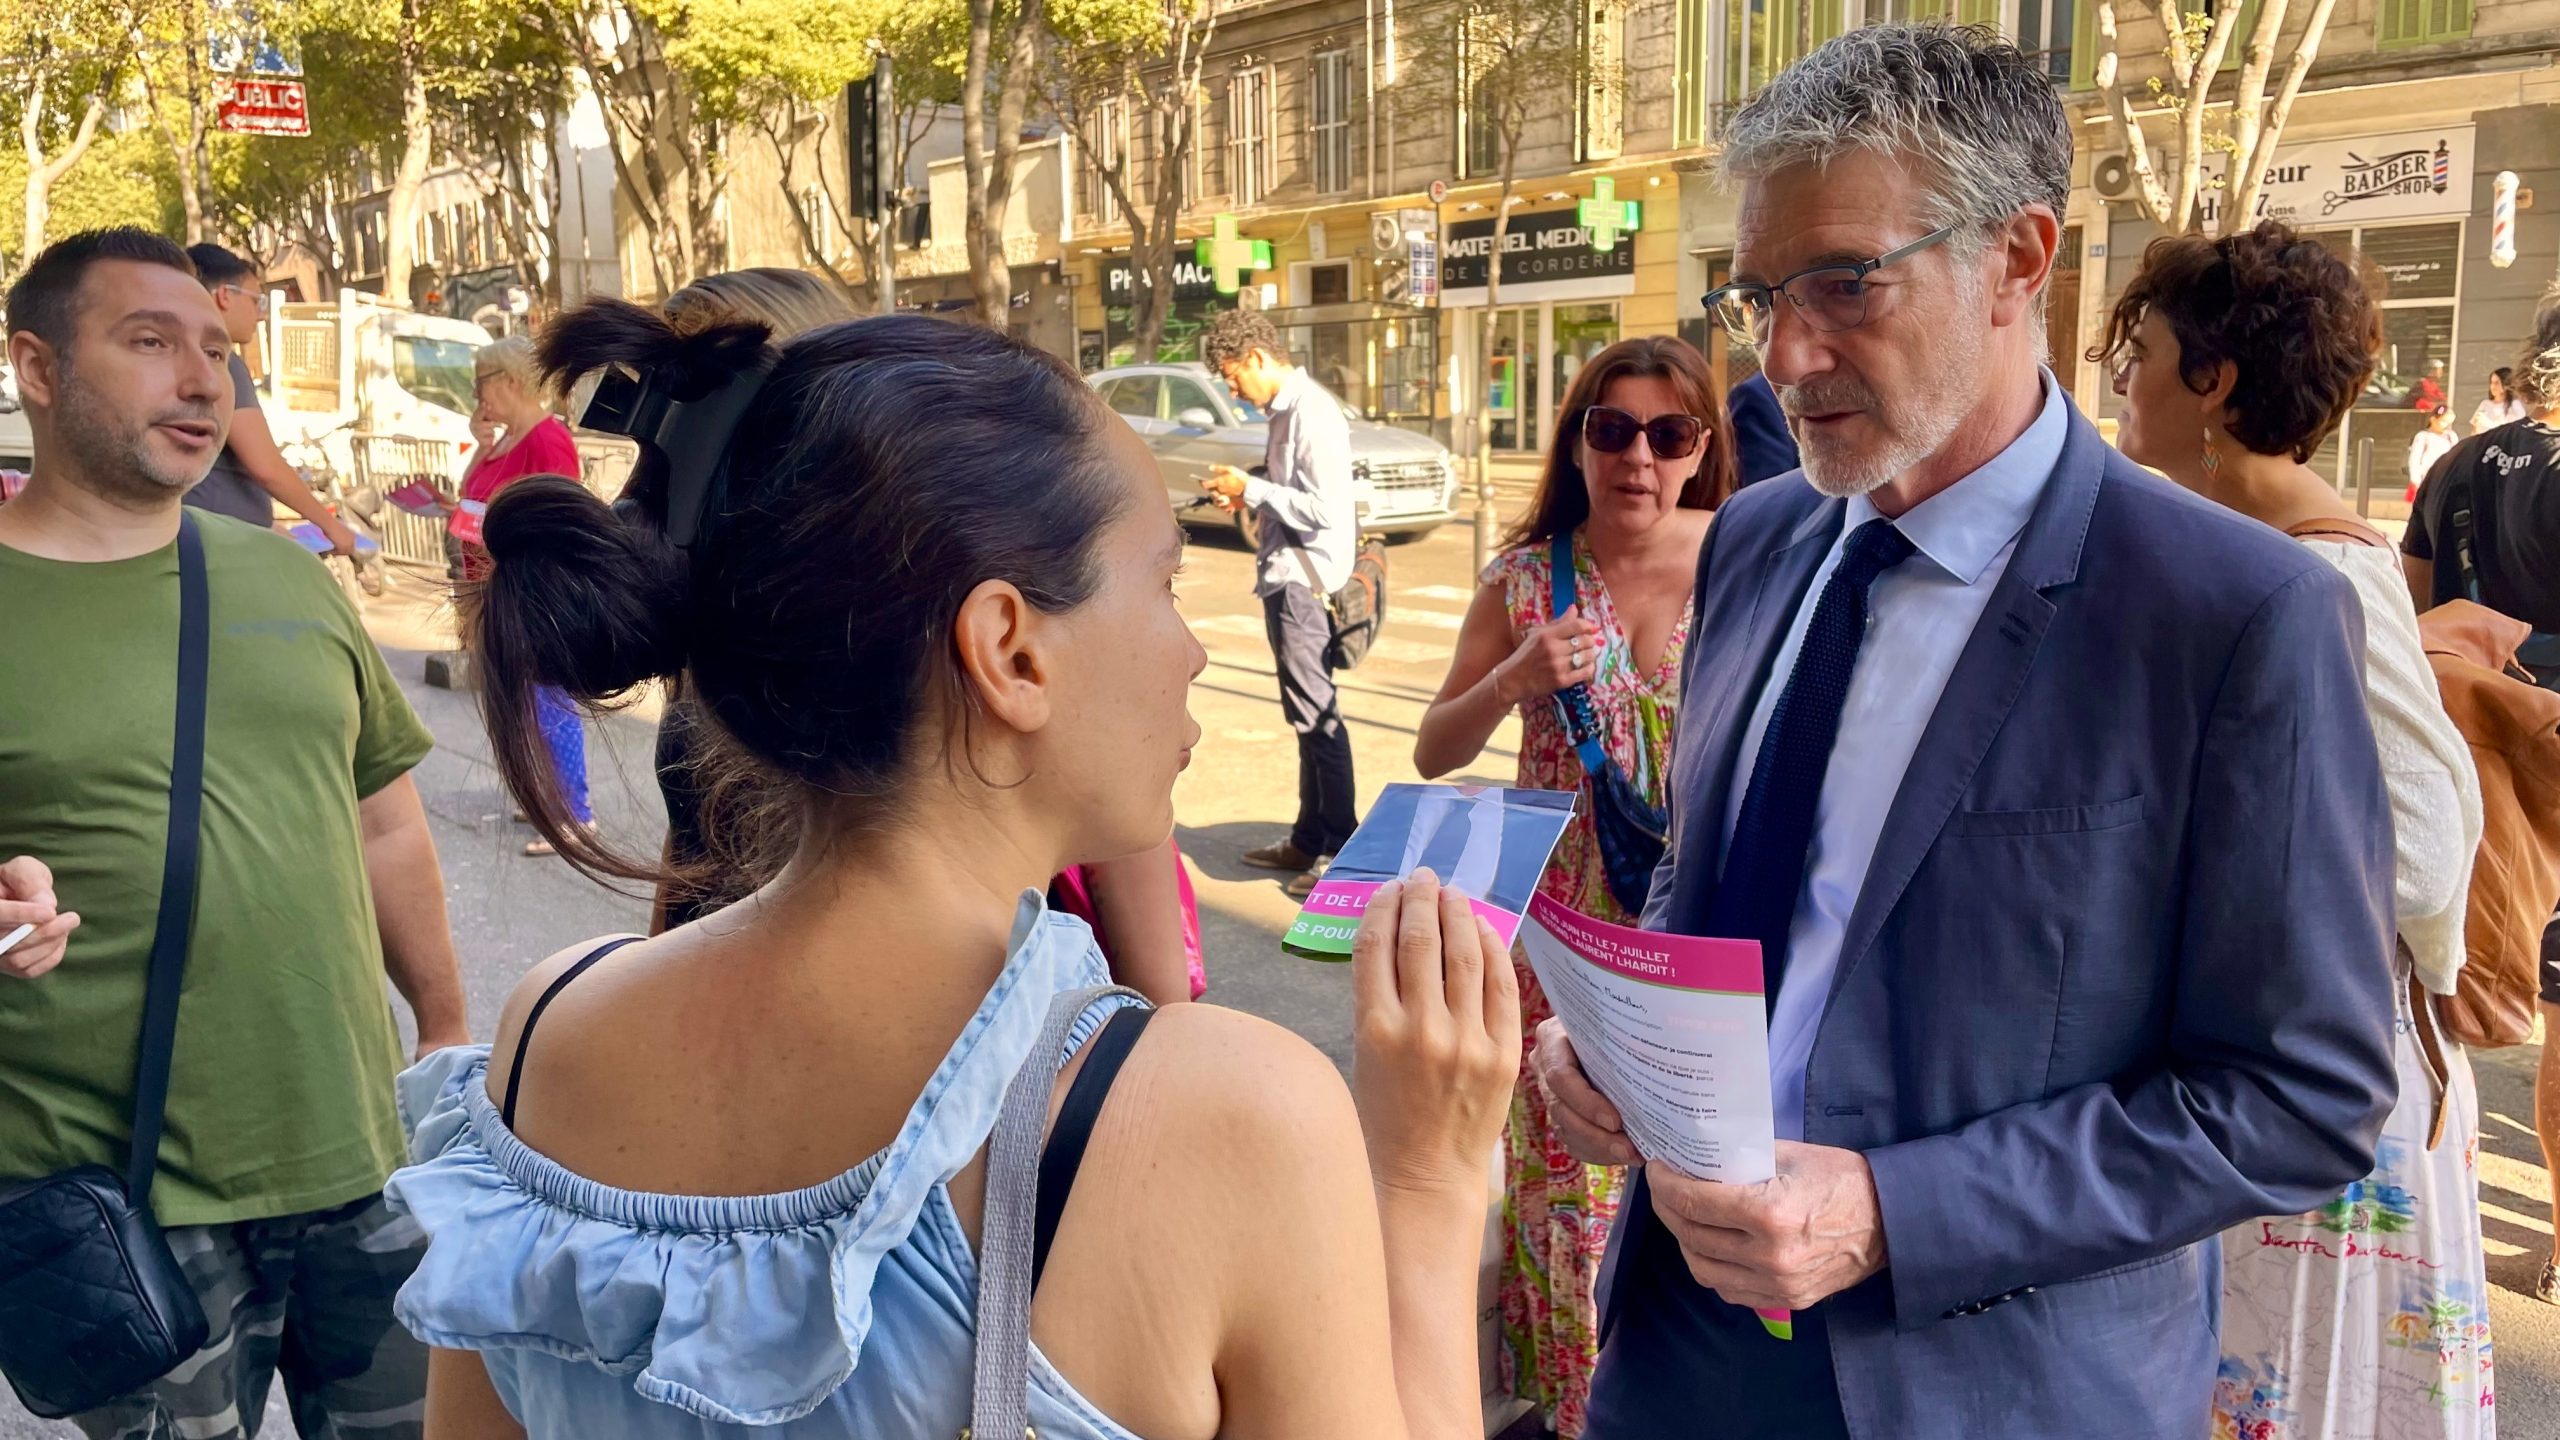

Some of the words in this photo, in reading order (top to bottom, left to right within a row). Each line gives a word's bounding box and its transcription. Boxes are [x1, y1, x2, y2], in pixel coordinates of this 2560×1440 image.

[2344, 155, 2427, 193] BARBER
[2393, 180, 2431, 195] SHOP
[1444, 266, 1468, 280] DE
[1517, 252, 1629, 275] CORDERIE
[1325, 893, 1352, 907] DE
[1561, 919, 1580, 938] JUIN
[1581, 931, 1593, 943] ET
[1596, 936, 1610, 950] LE
[1610, 942, 1618, 952] 7
[1620, 945, 1670, 963] JUILLET
[1570, 934, 1614, 963] LAURENT
[1617, 956, 1668, 976] LHARDIT
[1671, 967, 1677, 978] !
[2256, 1222, 2338, 1259] Santa
[2340, 1232, 2444, 1269] Barbara
